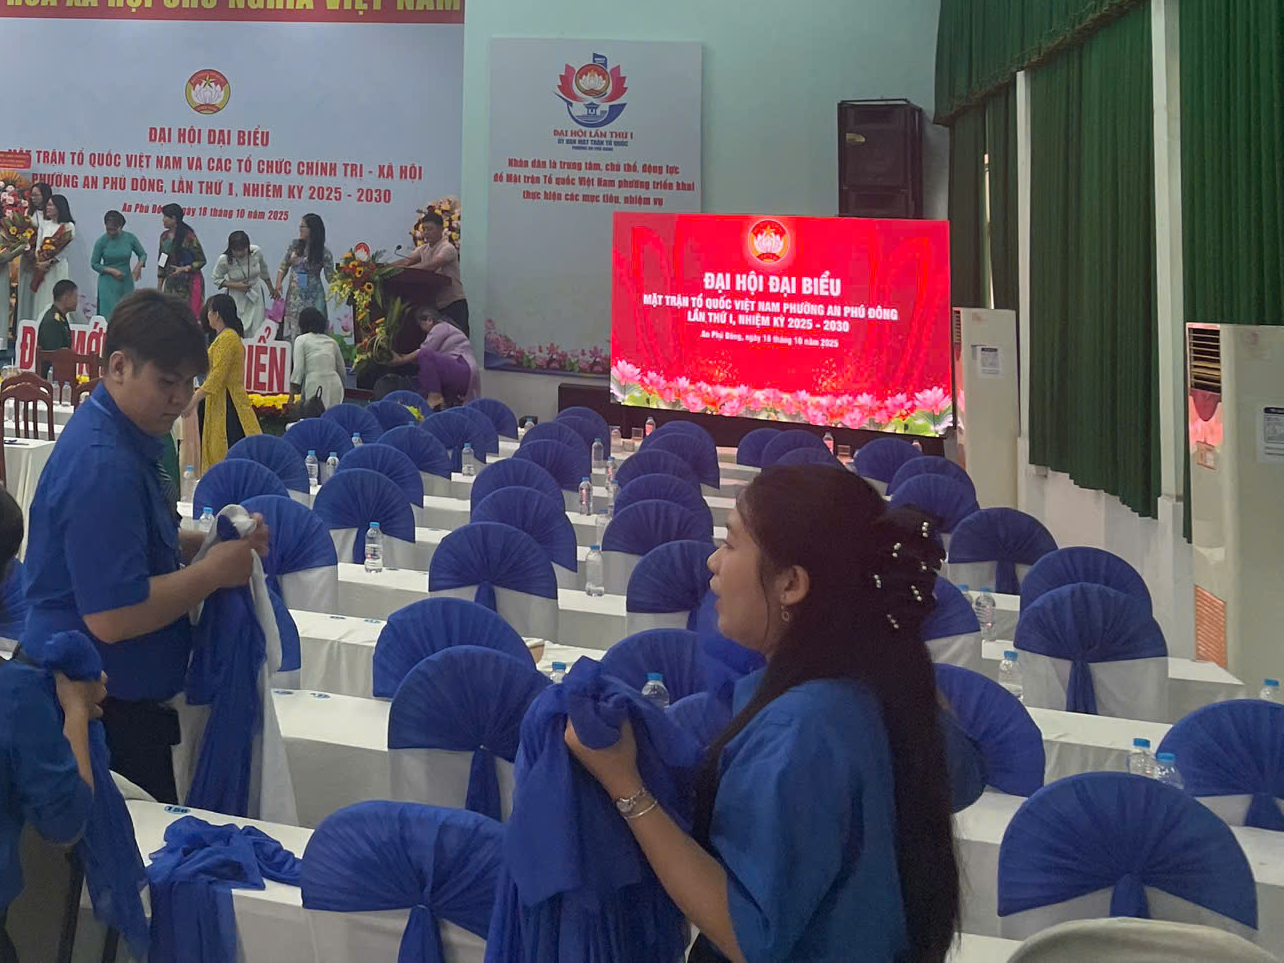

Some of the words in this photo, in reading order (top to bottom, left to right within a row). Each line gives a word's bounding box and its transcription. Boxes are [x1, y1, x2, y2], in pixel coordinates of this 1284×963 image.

[149, 127, 171, 146] ĐẠI
[178, 125, 201, 147] HỘI
[207, 129, 231, 148] ĐẠI
[237, 125, 270, 147] BIỂU
[36, 149, 65, 167] TRẬN
[70, 148, 84, 166] TỔ
[89, 149, 121, 168] QUỐC
[126, 152, 152, 169] VIỆT
[156, 155, 182, 170] NAM
[236, 154, 252, 173] TỔ
[257, 158, 292, 175] CHỨC
[342, 163, 363, 181] TRỊ
[378, 162, 394, 179] XÃ
[399, 163, 423, 183] HỘI
[83, 175, 98, 189] AN
[171, 177, 193, 194] LẦN
[198, 179, 224, 195] THỨ
[243, 181, 283, 200] NHIỆM
[308, 185, 342, 201] 2025
[356, 188, 392, 204] 2030
[236, 208, 245, 218] 10
[268, 210, 289, 221] 2025
[703, 271, 731, 293] ĐẠI
[735, 270, 763, 295] HỘI
[768, 275, 796, 297] ĐẠI
[802, 270, 841, 296] BIỂU
[643, 293, 663, 307] MẶT
[666, 294, 689, 309] TRẬN
[691, 293, 703, 308] TỔ
[705, 295, 732, 310] QUỐC
[734, 298, 756, 312] VIỆT
[758, 300, 780, 313] NAM
[783, 301, 825, 316] PHƯỜNG
[827, 305, 842, 317] AN
[844, 304, 866, 319] PHÚ
[867, 305, 899, 320] ĐÔNG
[687, 308, 705, 322] LẦN
[708, 309, 727, 324] THỨ
[729, 314, 736, 326] I,
[738, 313, 770, 328] NHIỆM
[773, 315, 785, 328] KỲ
[788, 318, 813, 330] 2025
[823, 320, 849, 332] 2030
